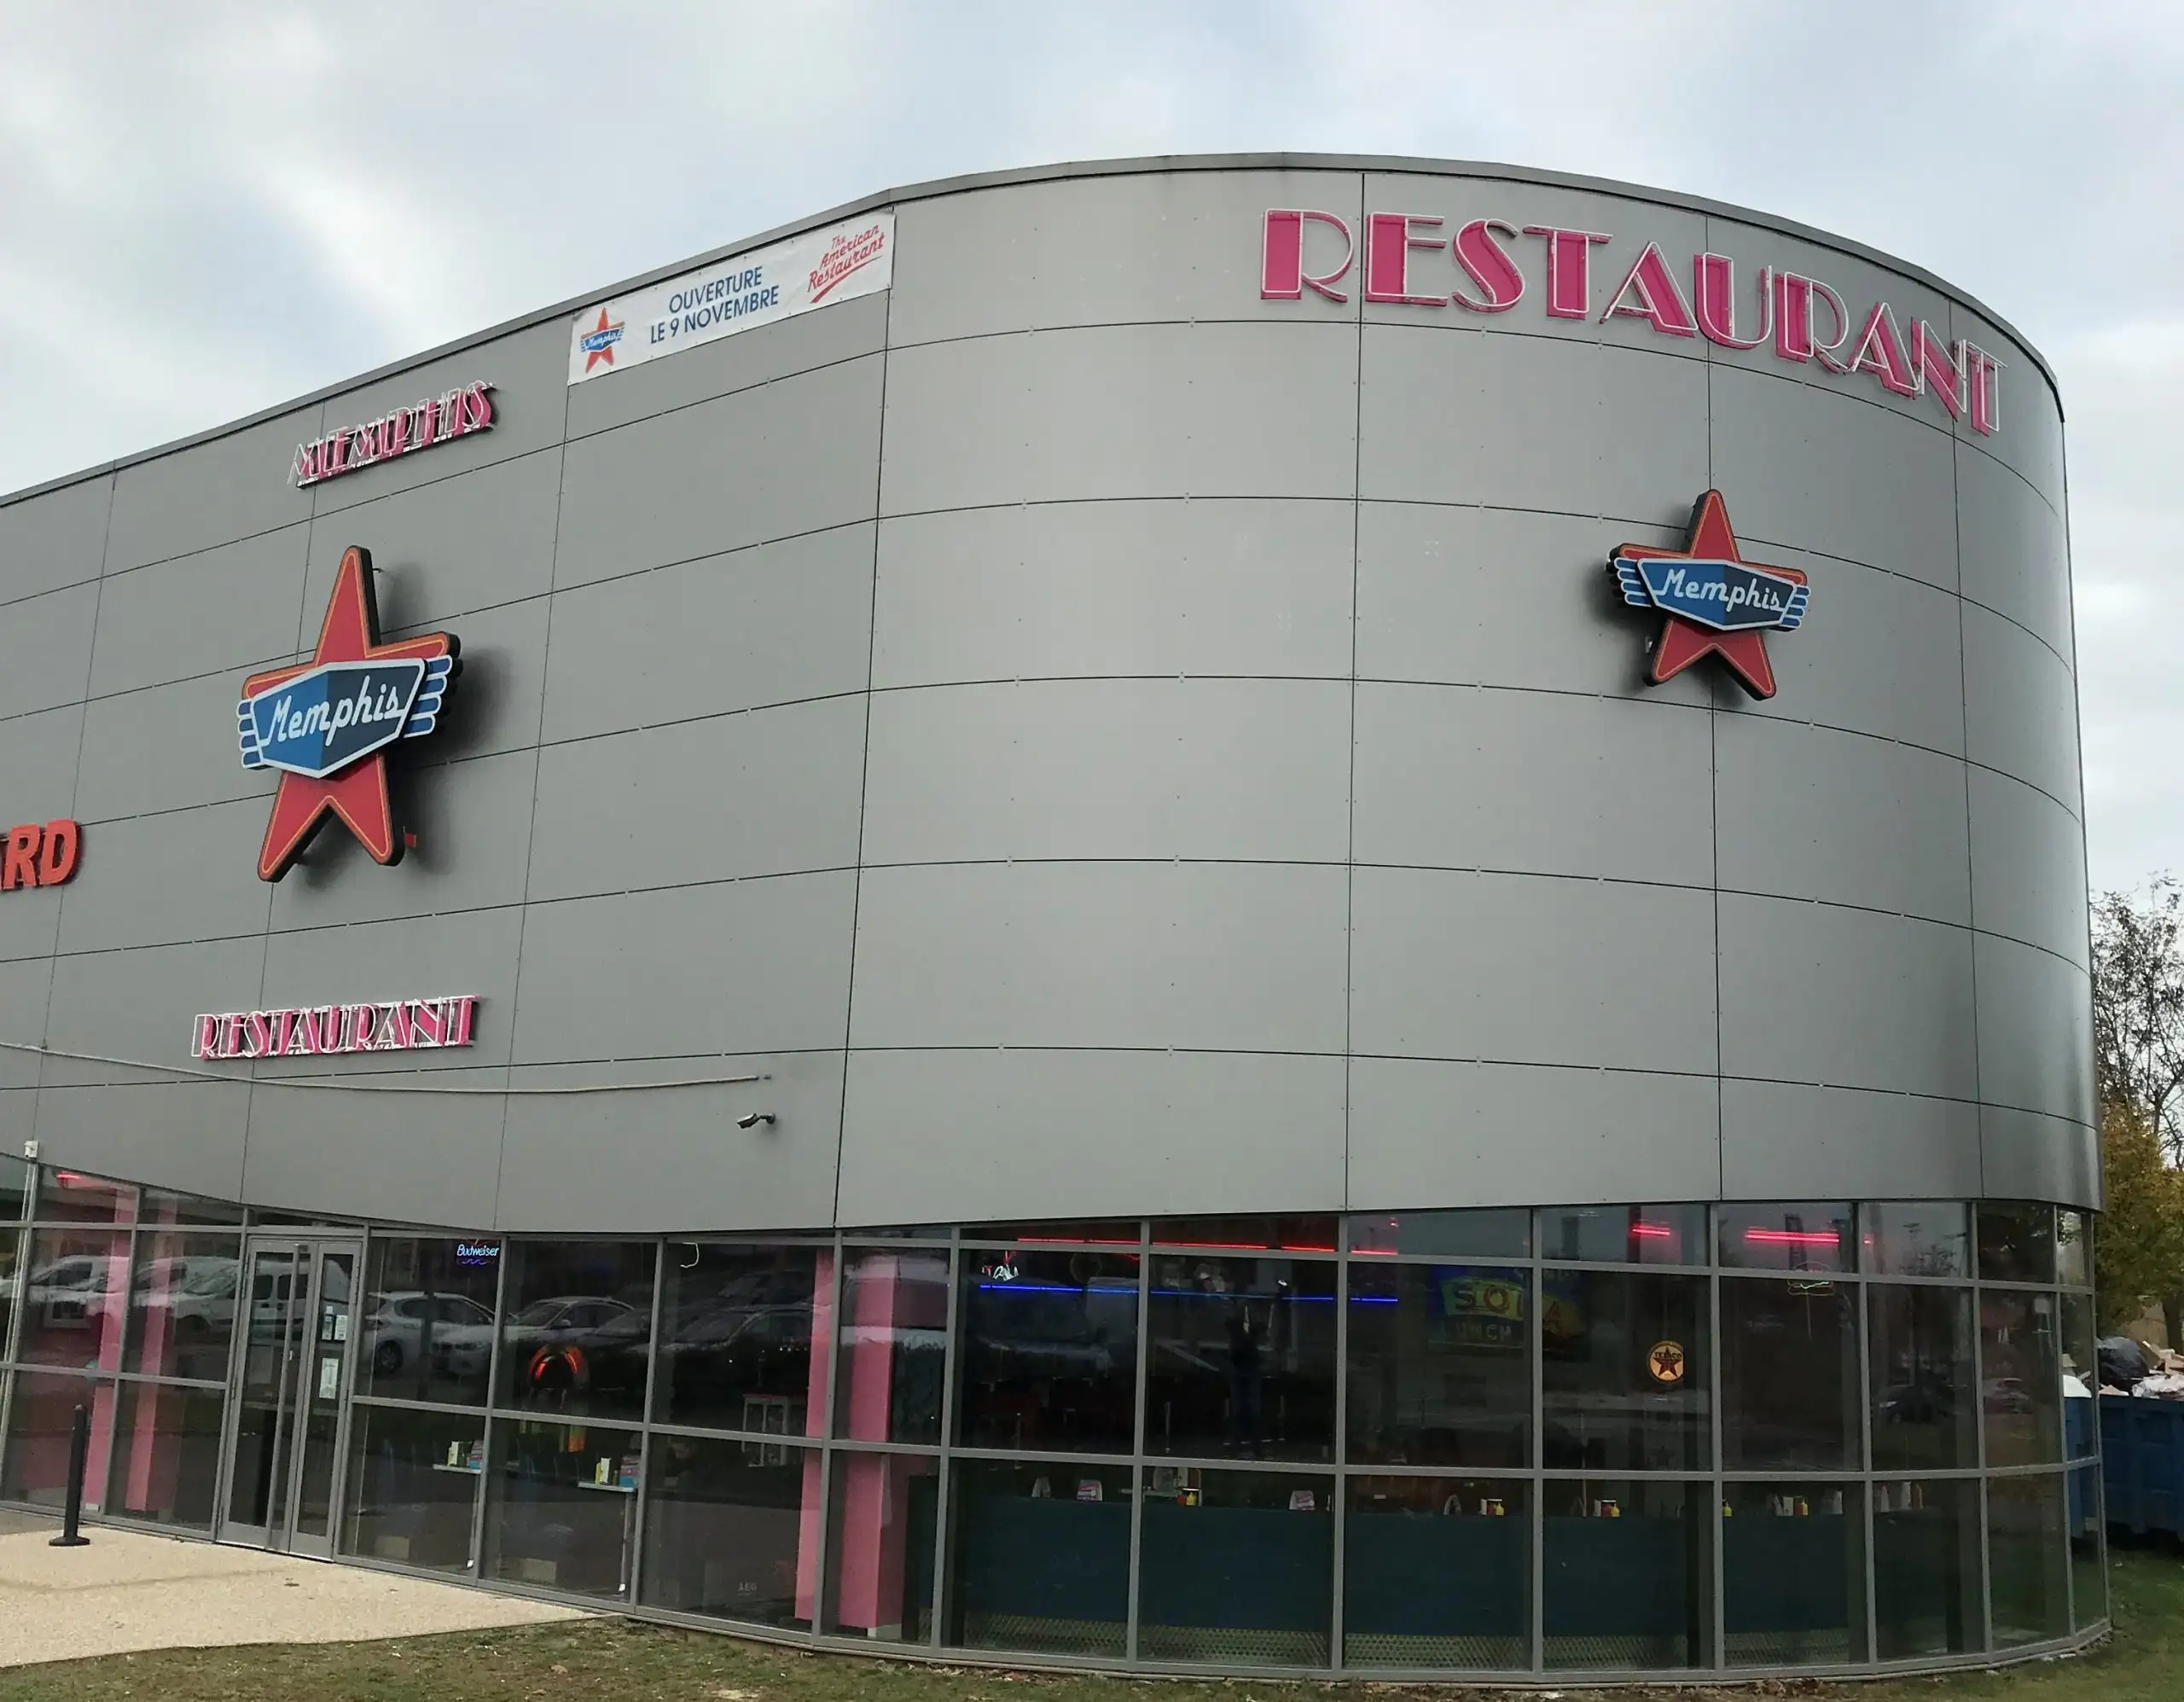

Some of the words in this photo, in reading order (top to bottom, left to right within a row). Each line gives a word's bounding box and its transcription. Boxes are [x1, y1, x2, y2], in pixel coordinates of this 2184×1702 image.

[807, 232, 886, 293] Restaurant
[819, 224, 880, 270] American
[832, 235, 846, 250] The
[650, 321, 665, 345] LE
[670, 317, 680, 338] 9
[684, 285, 780, 333] NOVEMBRE
[669, 265, 763, 314] OUVERTURE
[1261, 207, 2008, 436] RESTAURANT
[1653, 568, 1786, 613] Memphis
[259, 675, 409, 746] Memphis
[0, 819, 78, 889] RD
[191, 994, 482, 1060] RESTAURANT
[456, 1244, 499, 1257] Budweiser
